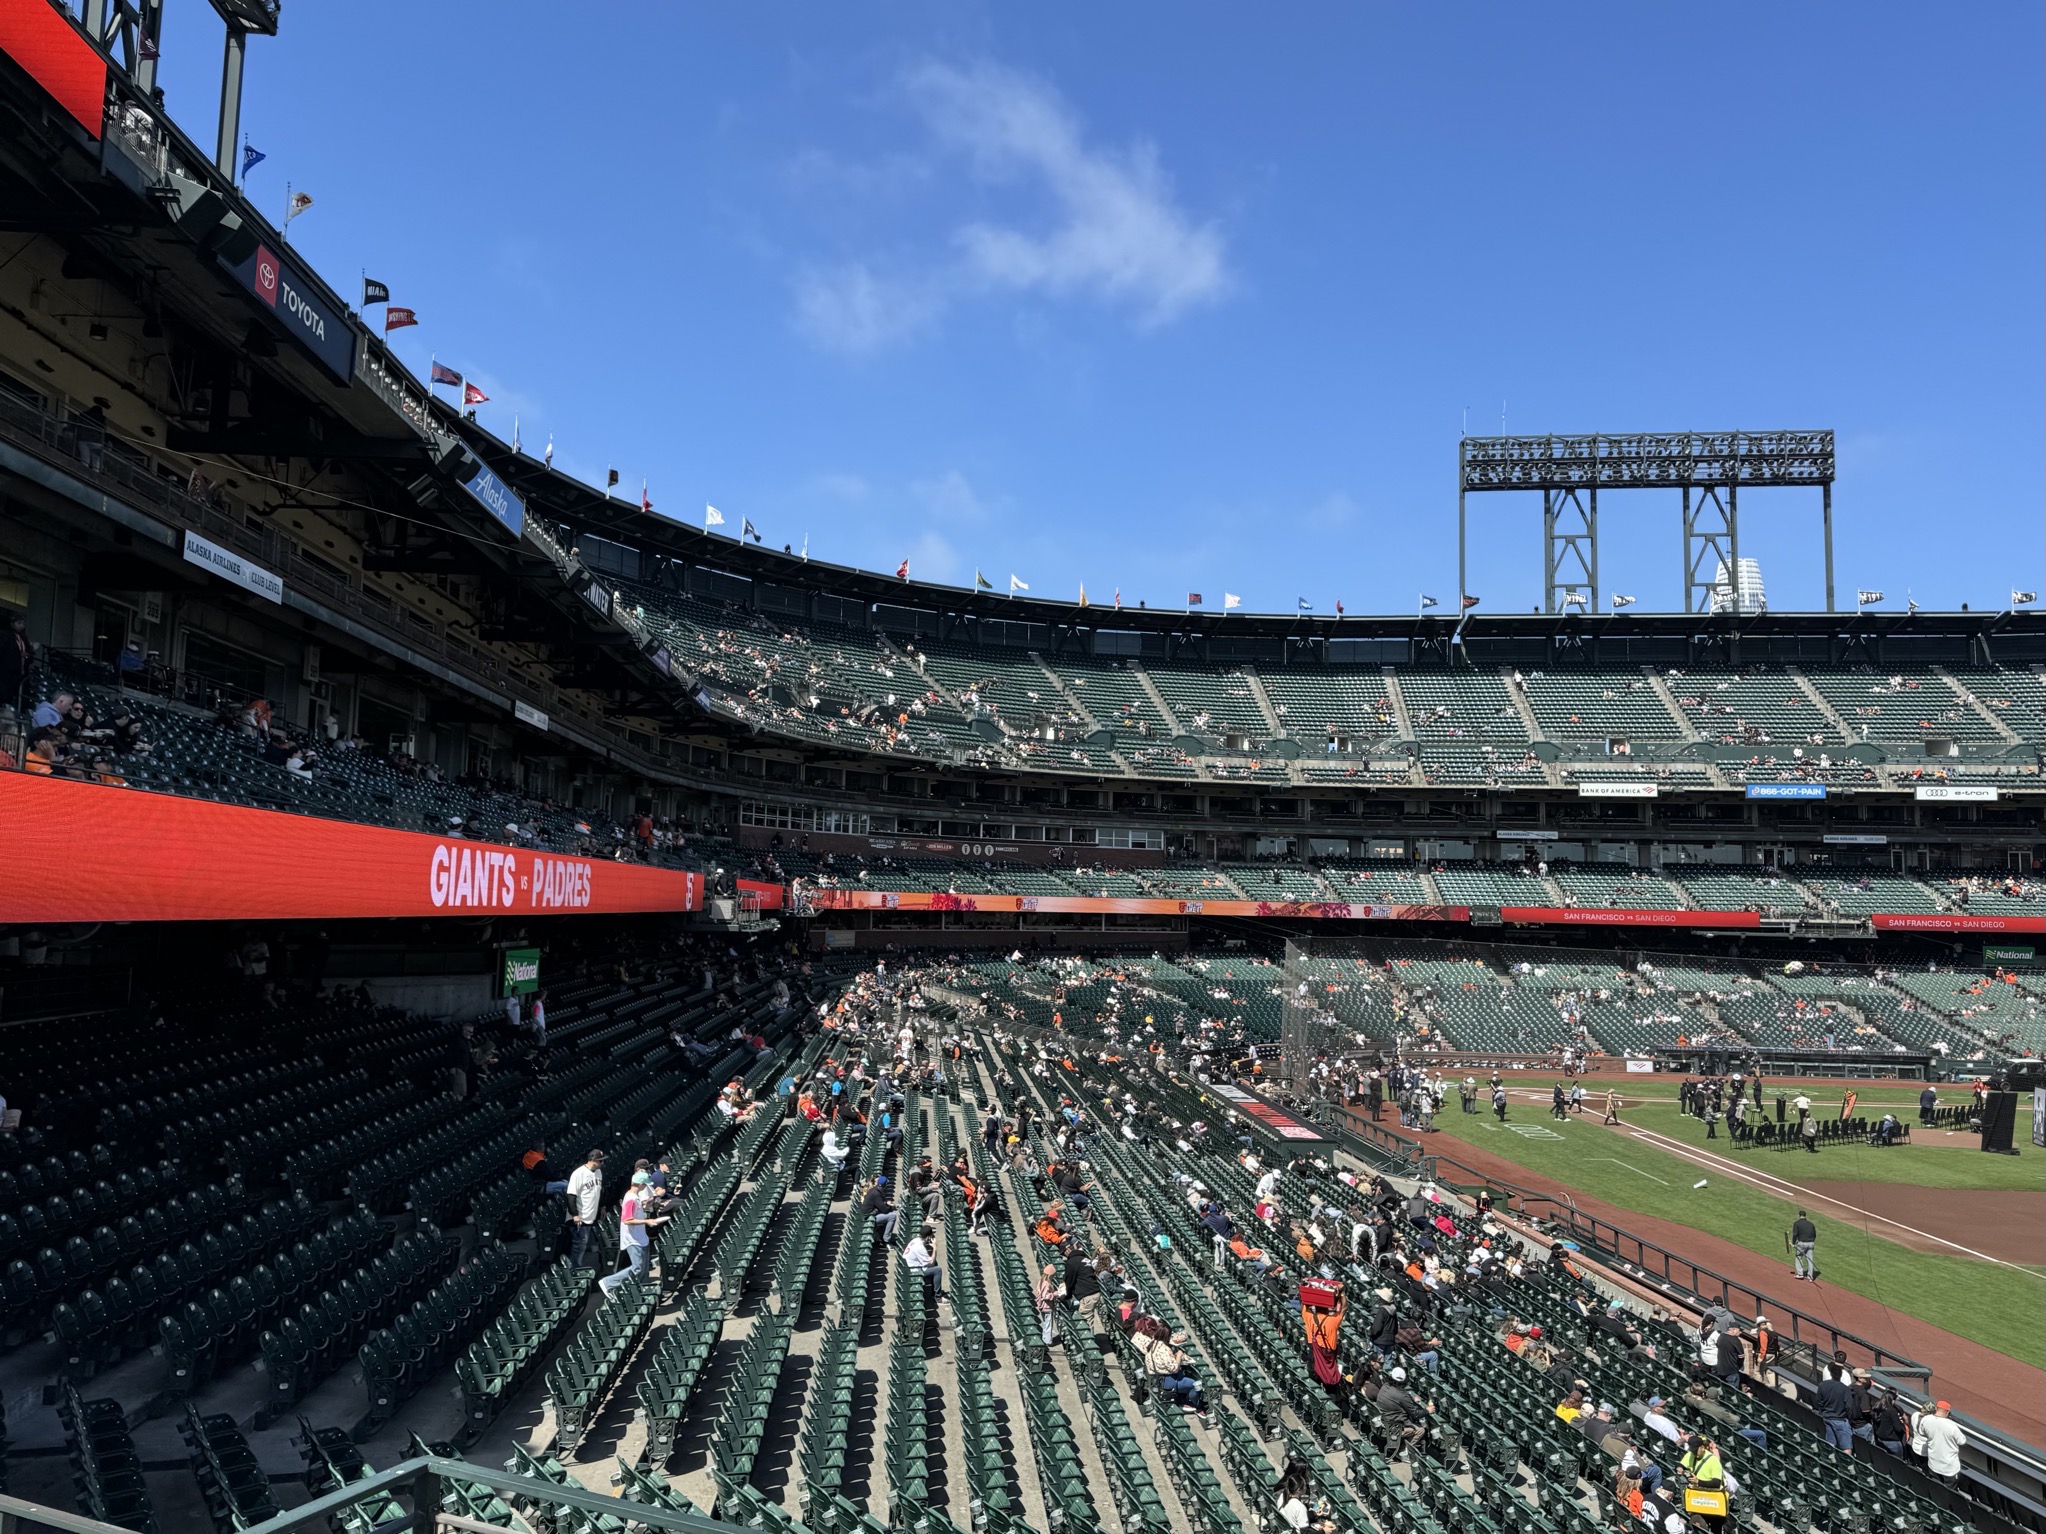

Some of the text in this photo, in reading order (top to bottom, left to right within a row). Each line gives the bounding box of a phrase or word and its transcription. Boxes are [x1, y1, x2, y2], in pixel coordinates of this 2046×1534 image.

[282, 282, 325, 341] TOYOTA
[477, 474, 508, 517] Alaska
[187, 540, 281, 596] ALASKA AIRLINES CLUB LEVEL
[1760, 788, 1822, 796] 866-GOT-PAIN
[430, 844, 516, 908] GIANTS
[531, 857, 592, 907] PADRES
[1564, 912, 1580, 920] SAN
[1581, 913, 1625, 921] FRANCISCO
[1635, 914, 1651, 922] SAN
[1888, 919, 1905, 927] SAN
[1906, 920, 1952, 928] FRANCISCO
[1996, 950, 2033, 960] National
[513, 959, 539, 982] National
